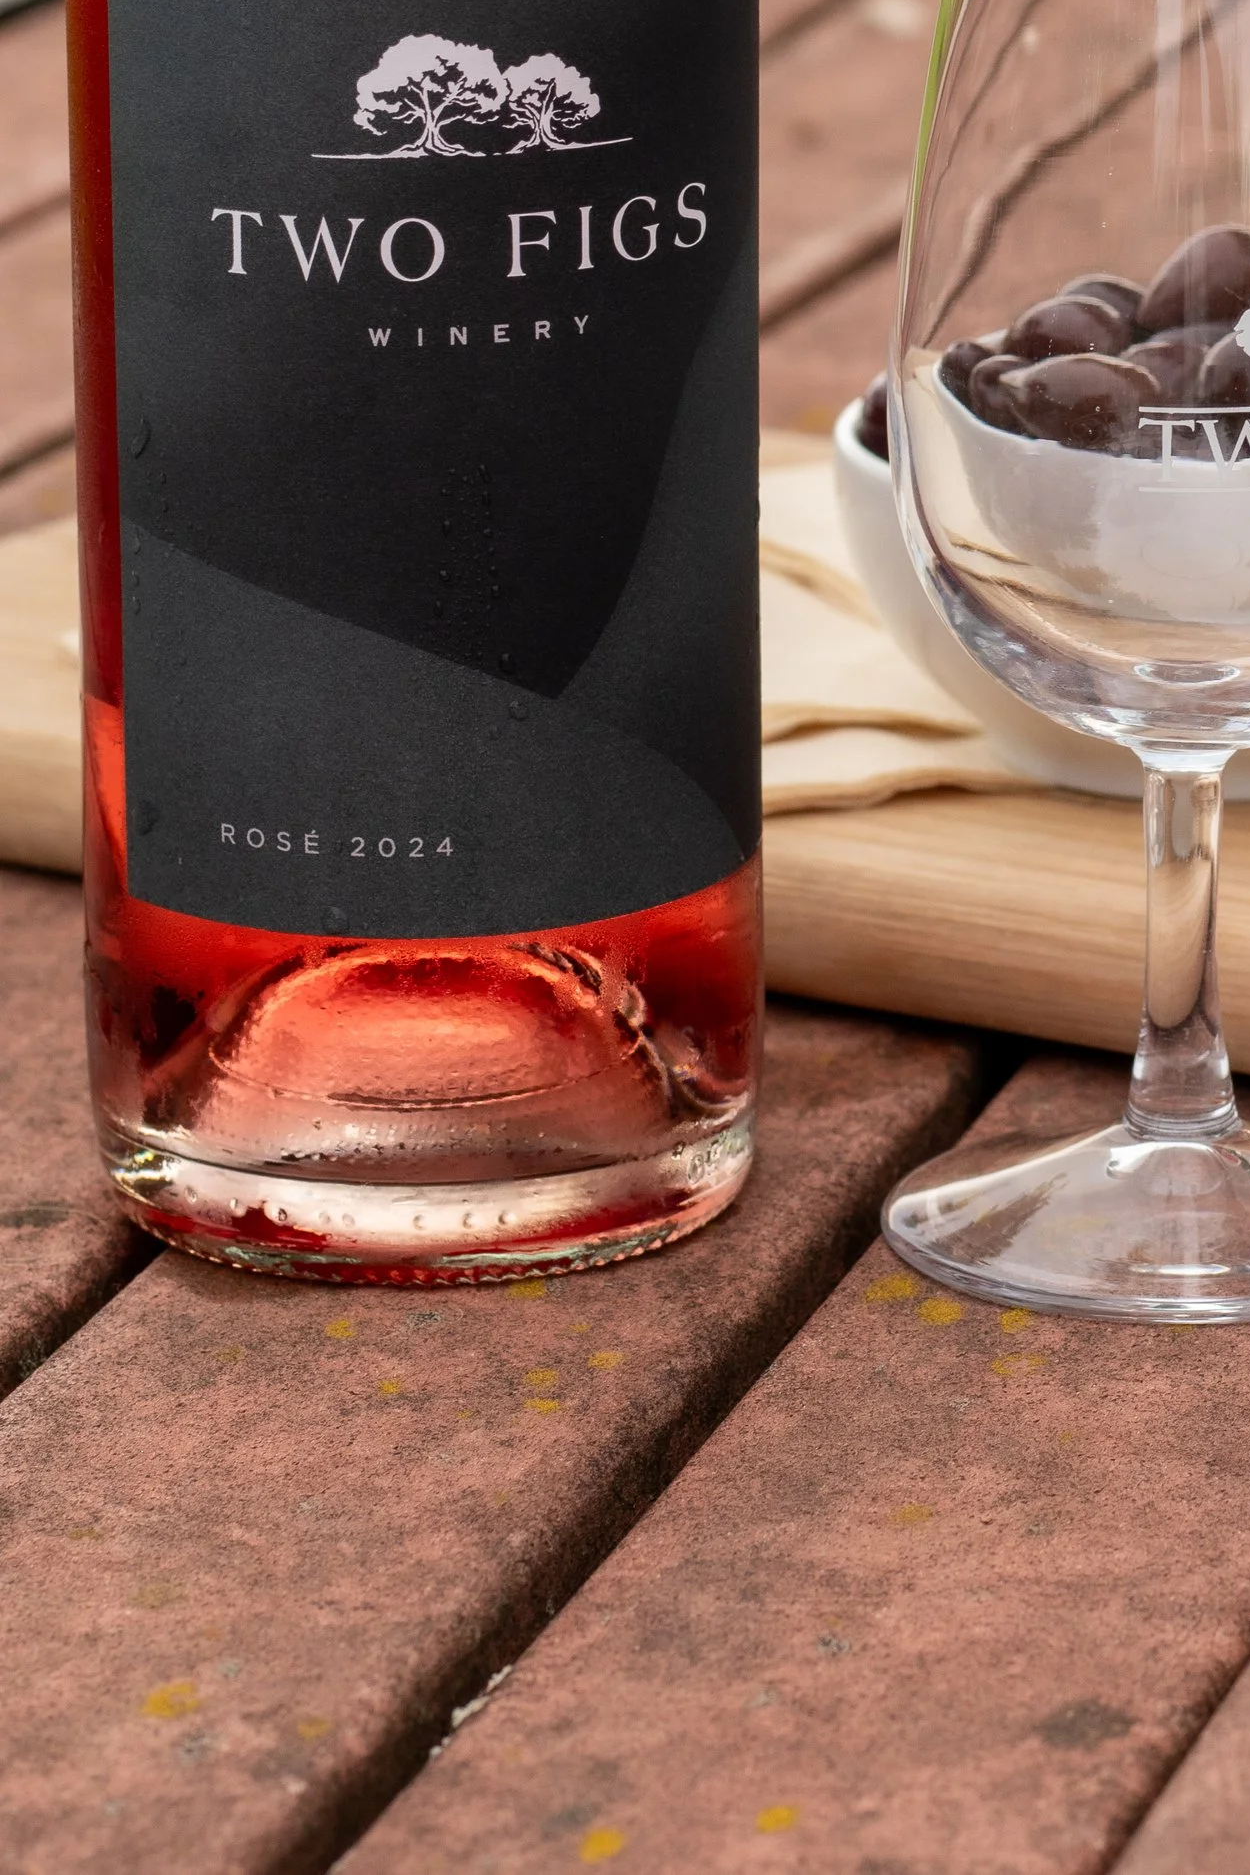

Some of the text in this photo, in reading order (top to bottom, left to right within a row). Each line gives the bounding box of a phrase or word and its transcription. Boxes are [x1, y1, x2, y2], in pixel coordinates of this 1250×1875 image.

[210, 181, 708, 284] TWO FIGS
[367, 314, 590, 348] WINERY
[220, 822, 454, 858] ROSÉ 2024
